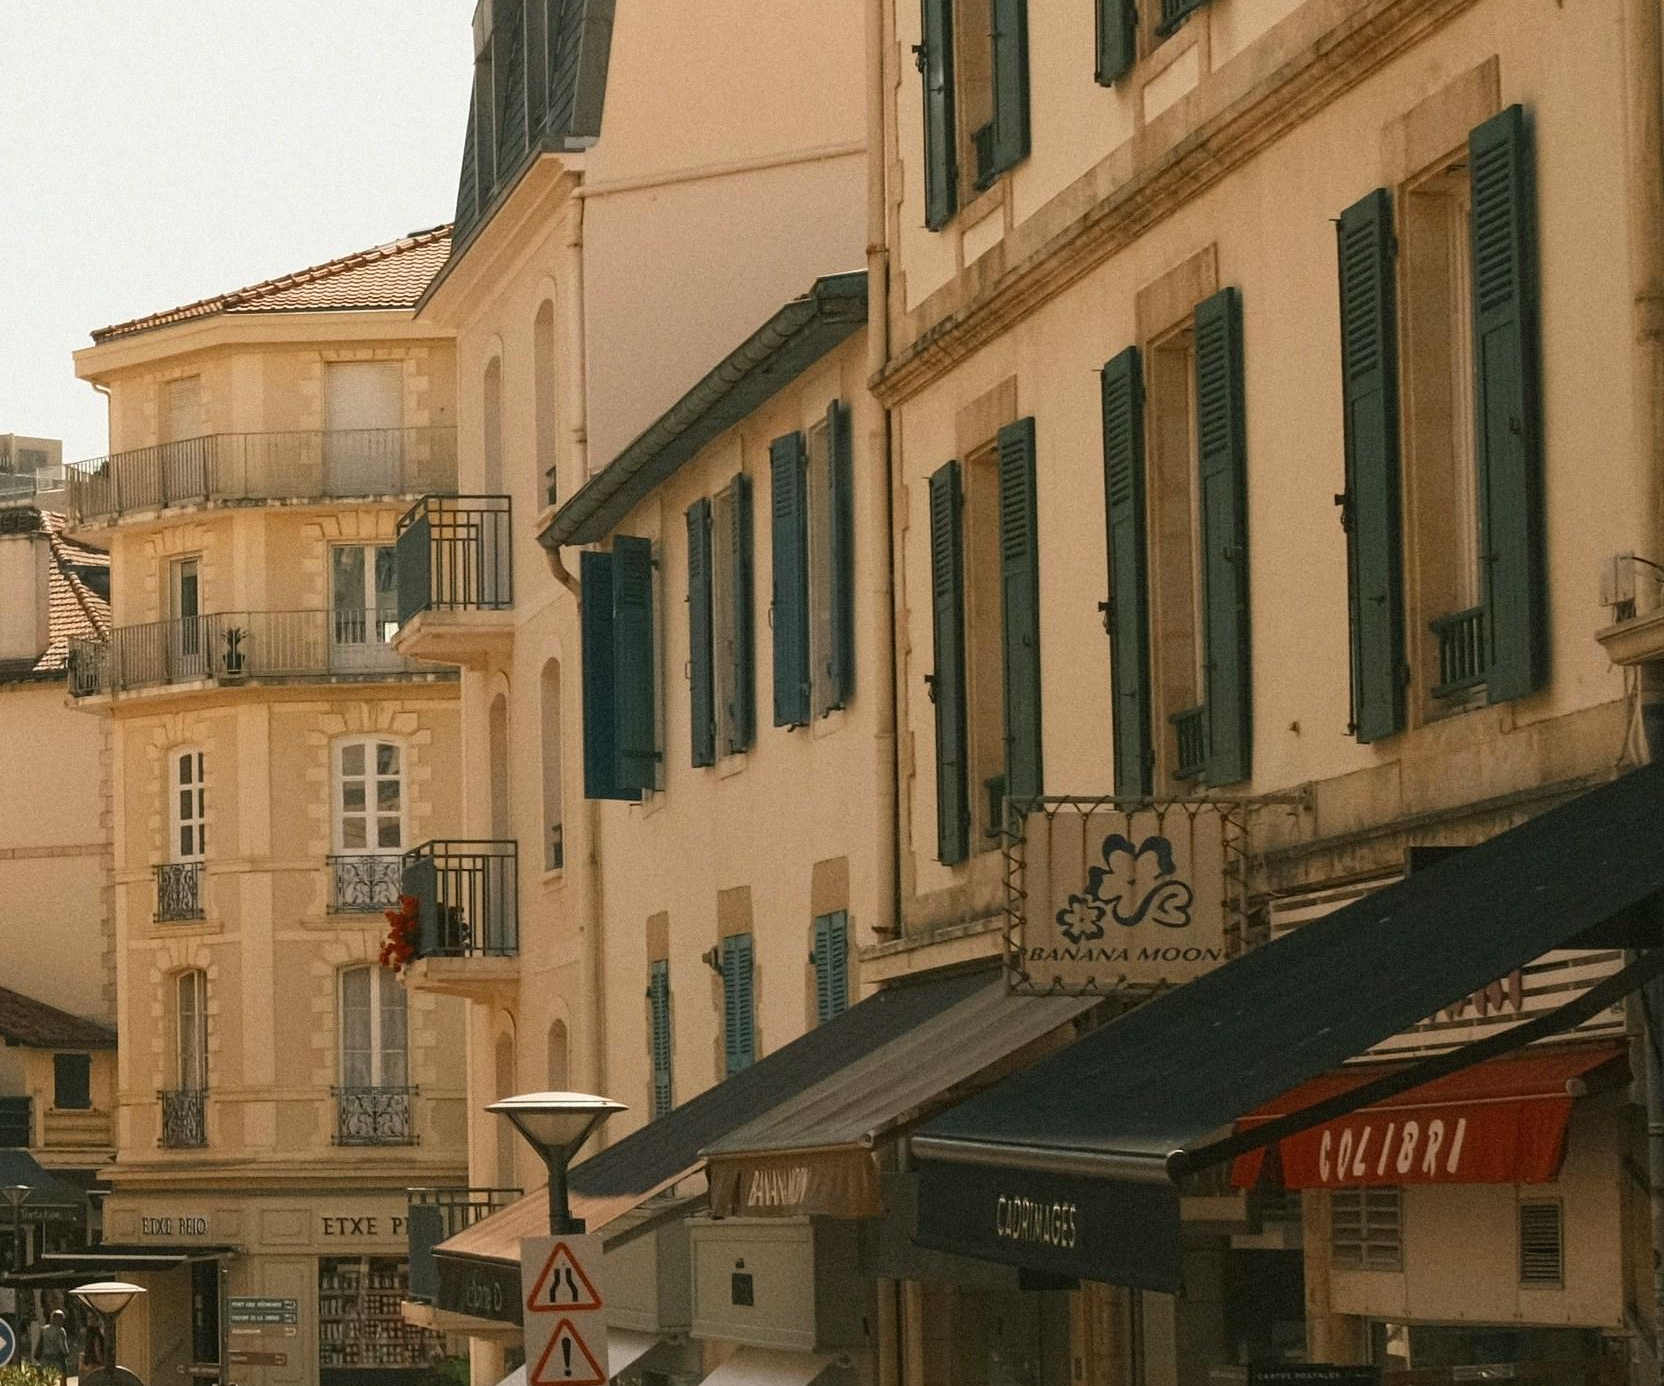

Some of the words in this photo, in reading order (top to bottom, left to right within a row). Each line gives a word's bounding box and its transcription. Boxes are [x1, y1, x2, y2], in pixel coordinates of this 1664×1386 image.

[1028, 946, 1129, 962] BANANA
[1136, 946, 1222, 962] MOON
[1318, 1117, 1467, 1182] COLIBRI
[322, 1217, 378, 1235] ETXE
[392, 1217, 409, 1235] P
[997, 1196, 1076, 1248] CADRIMAGES
